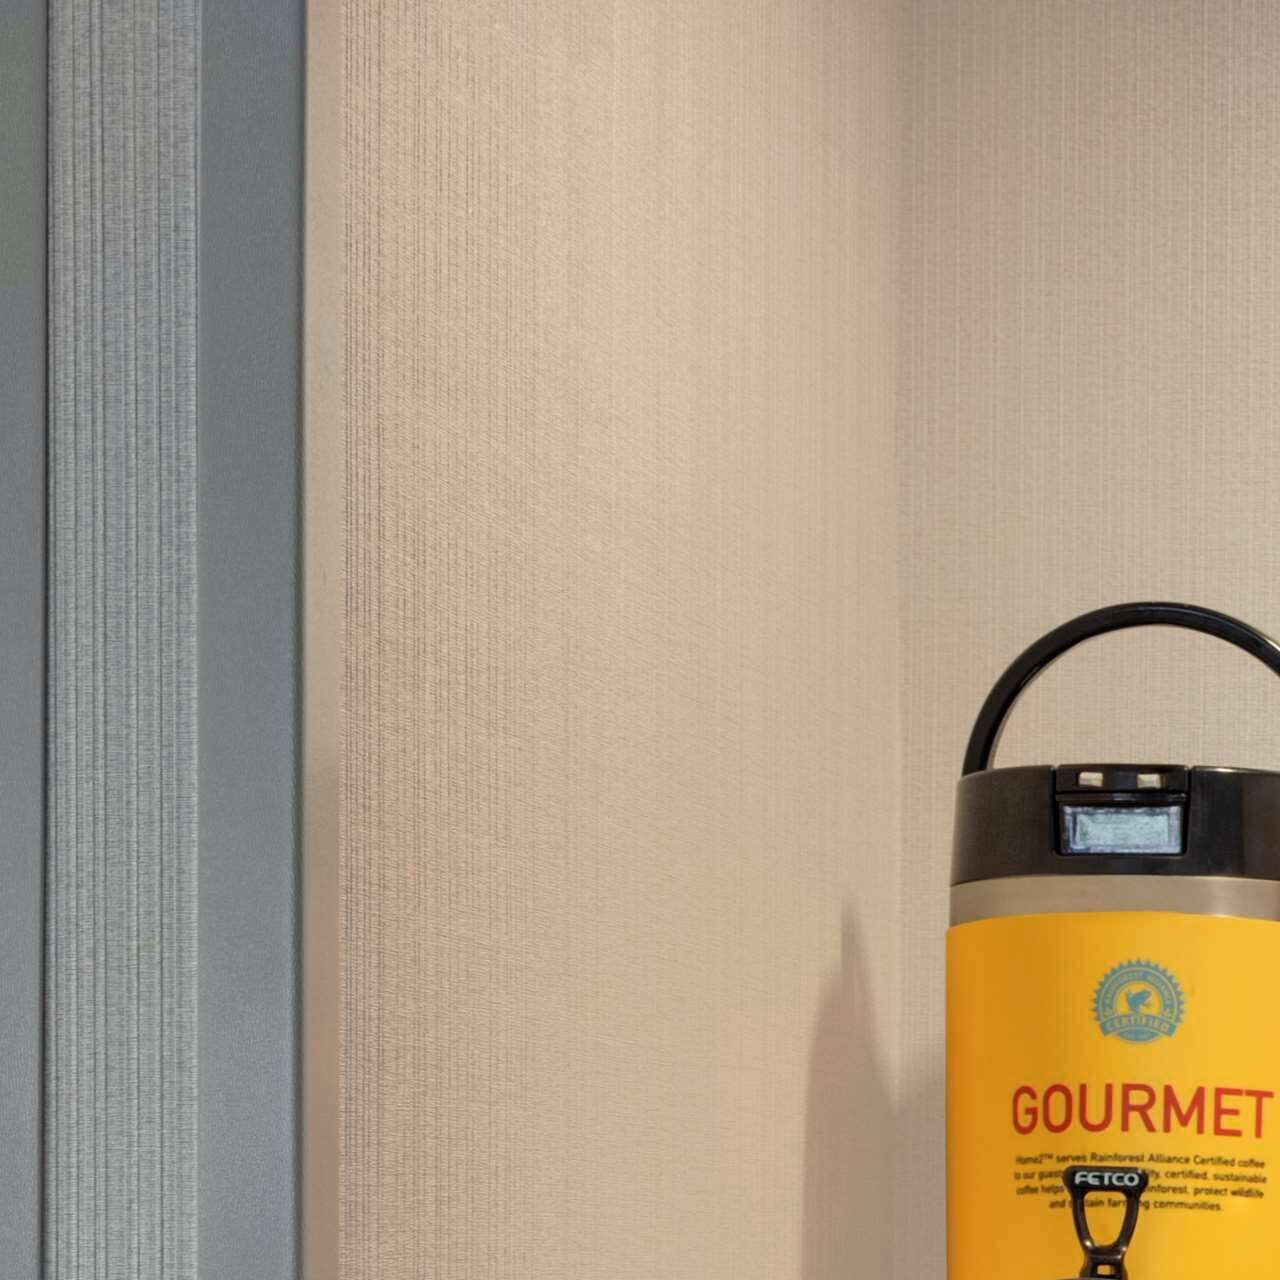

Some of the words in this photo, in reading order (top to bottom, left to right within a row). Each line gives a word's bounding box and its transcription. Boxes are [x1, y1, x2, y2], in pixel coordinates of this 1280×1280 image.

[1012, 1083, 1275, 1139] GOURMET
[1056, 1154, 1087, 1163] serves
[1090, 1152, 1144, 1163] Rainforest
[1148, 1153, 1190, 1164] Alliance
[1193, 1155, 1235, 1167] Certified
[1238, 1158, 1265, 1168] coffee
[1023, 1172, 1036, 1180] our
[1074, 1171, 1140, 1186] FETCO
[1213, 1173, 1267, 1183] sustainable
[1016, 1185, 1038, 1195] coffee
[1040, 1184, 1065, 1195] helps
[1193, 1186, 1228, 1197] protect
[1231, 1187, 1264, 1199] wildlife
[1049, 1199, 1066, 1208] and
